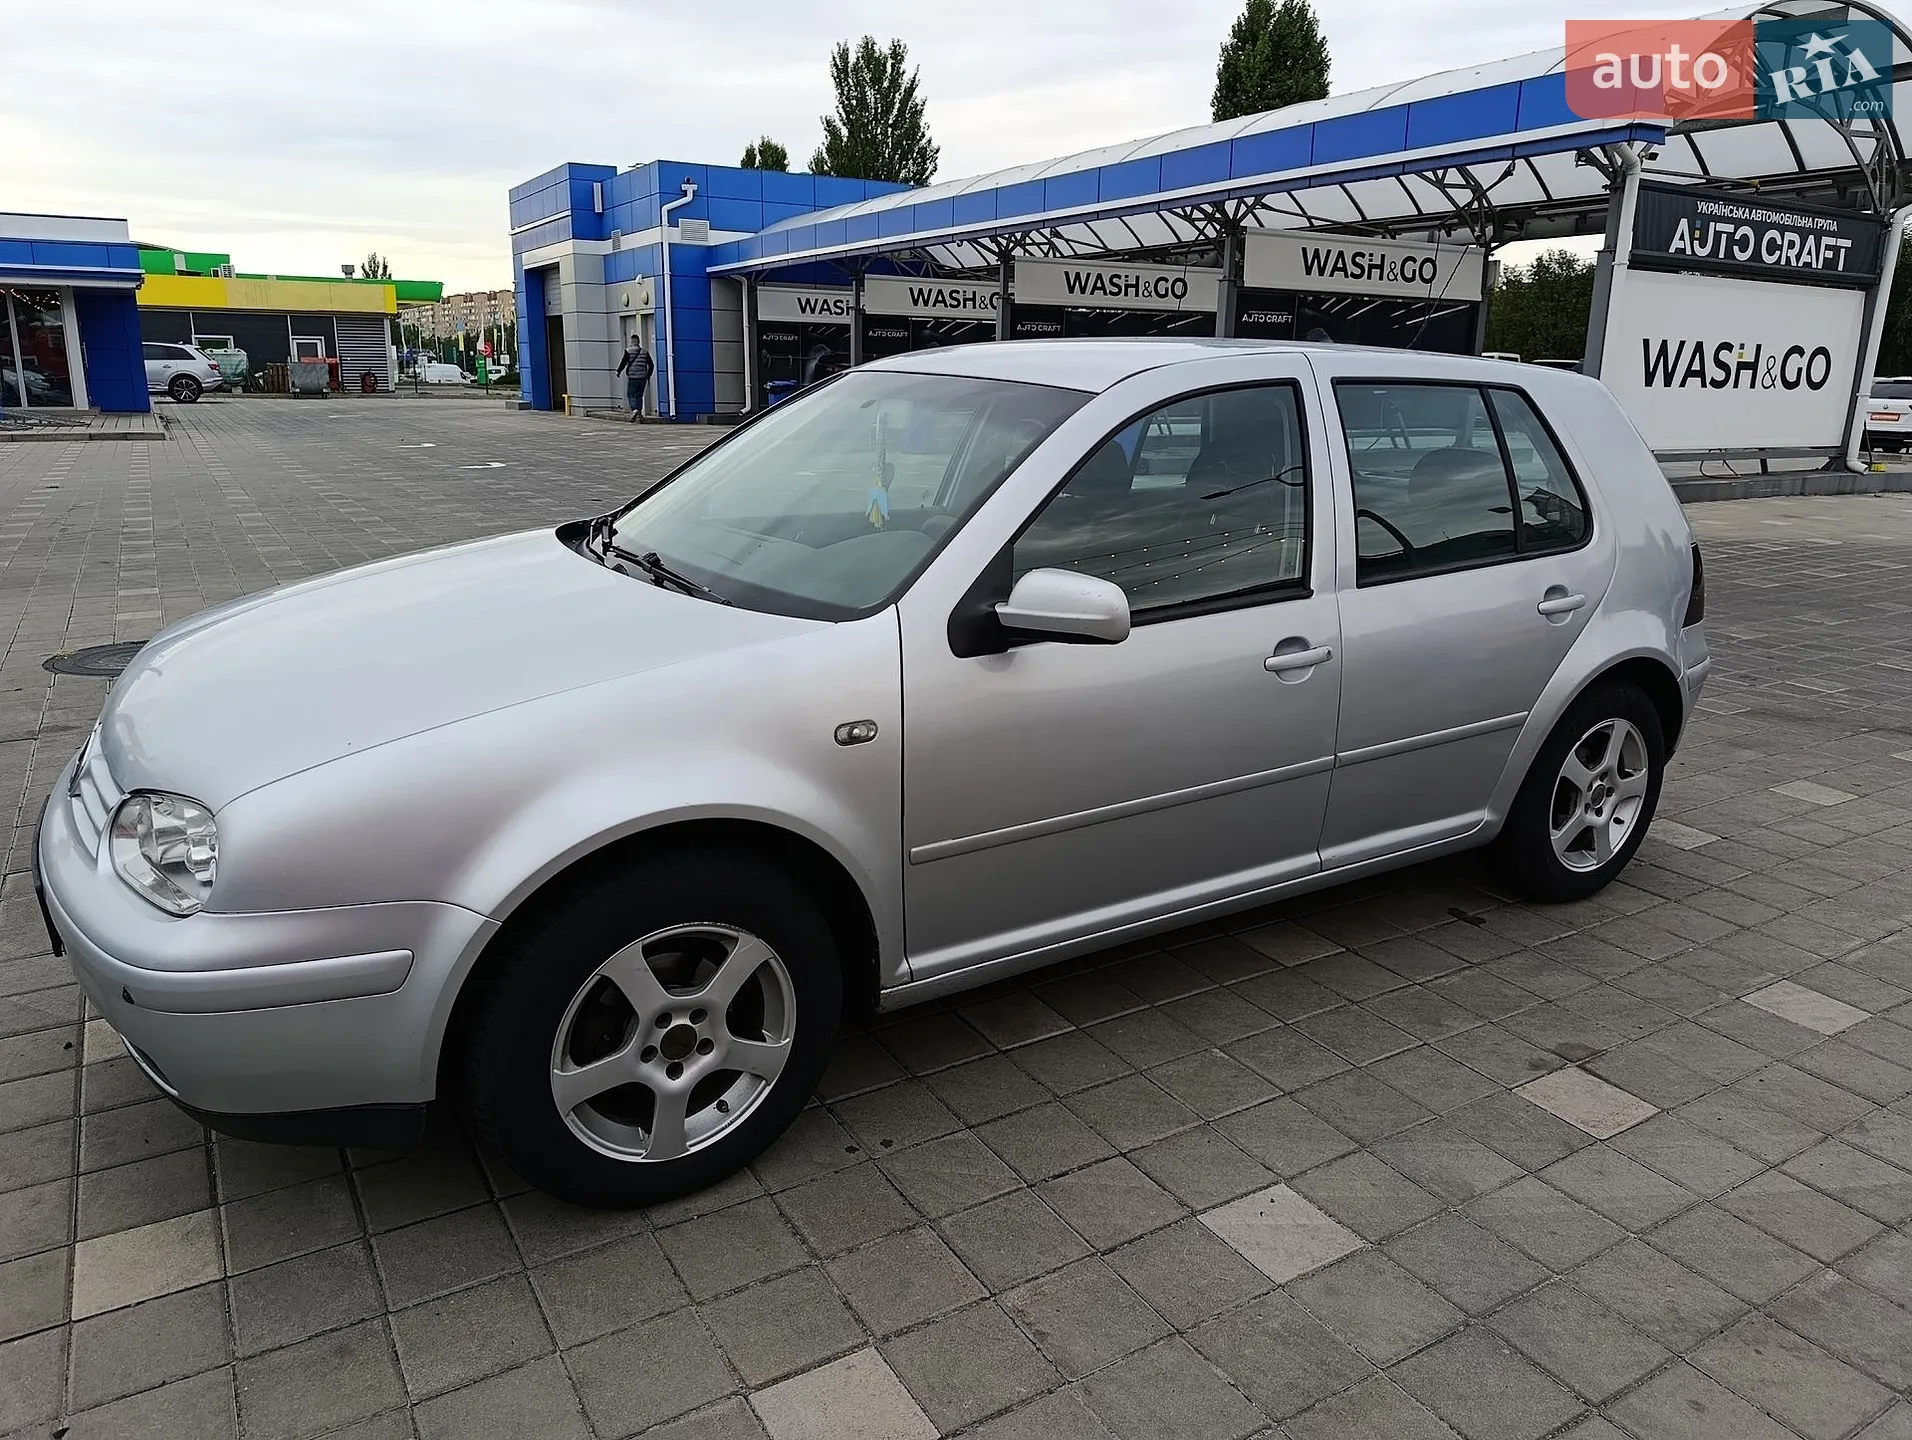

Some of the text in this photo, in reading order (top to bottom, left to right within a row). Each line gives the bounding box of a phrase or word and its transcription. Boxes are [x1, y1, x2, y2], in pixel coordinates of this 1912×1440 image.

[1697, 201, 1838, 232] УКРАЇНСЬКА АВТОМОБІЛЬНА ГРУПА
[1669, 217, 1852, 272] AUTO CRAFT
[1301, 246, 1438, 285] WASH&GO
[1064, 270, 1188, 300] WASH&GO
[1242, 314, 1293, 323] AUTO CRAFT
[1642, 338, 1832, 391] WASH&GO
